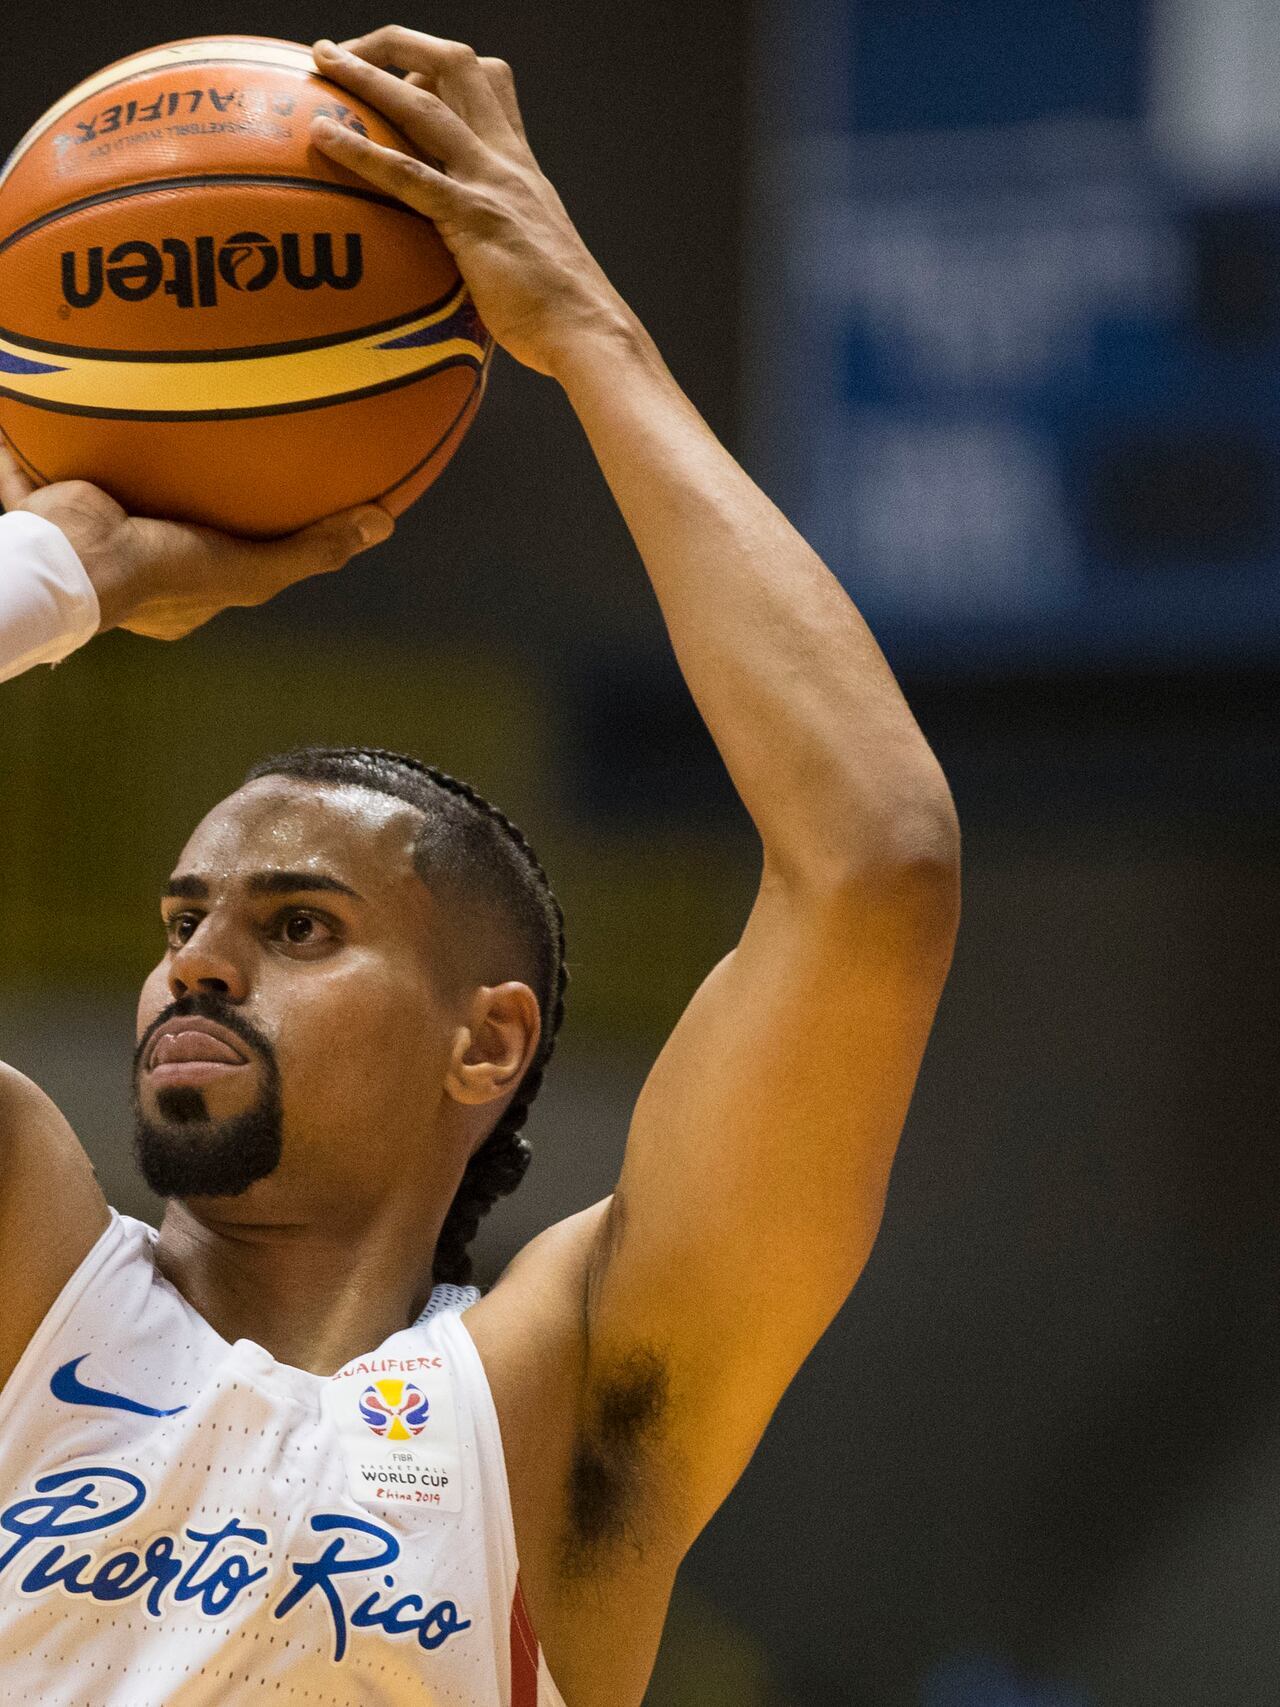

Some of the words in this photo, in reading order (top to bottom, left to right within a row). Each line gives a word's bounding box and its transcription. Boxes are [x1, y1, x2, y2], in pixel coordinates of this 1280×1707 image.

[61, 231, 363, 308] molten
[392, 1453, 414, 1462] FIBA
[360, 1464, 447, 1474] BASKETBALL
[361, 1471, 417, 1484] WORLD
[421, 1475, 449, 1488] CUP
[376, 1488, 412, 1501] China
[415, 1490, 441, 1504] 2019
[275, 1513, 472, 1662] Rico
